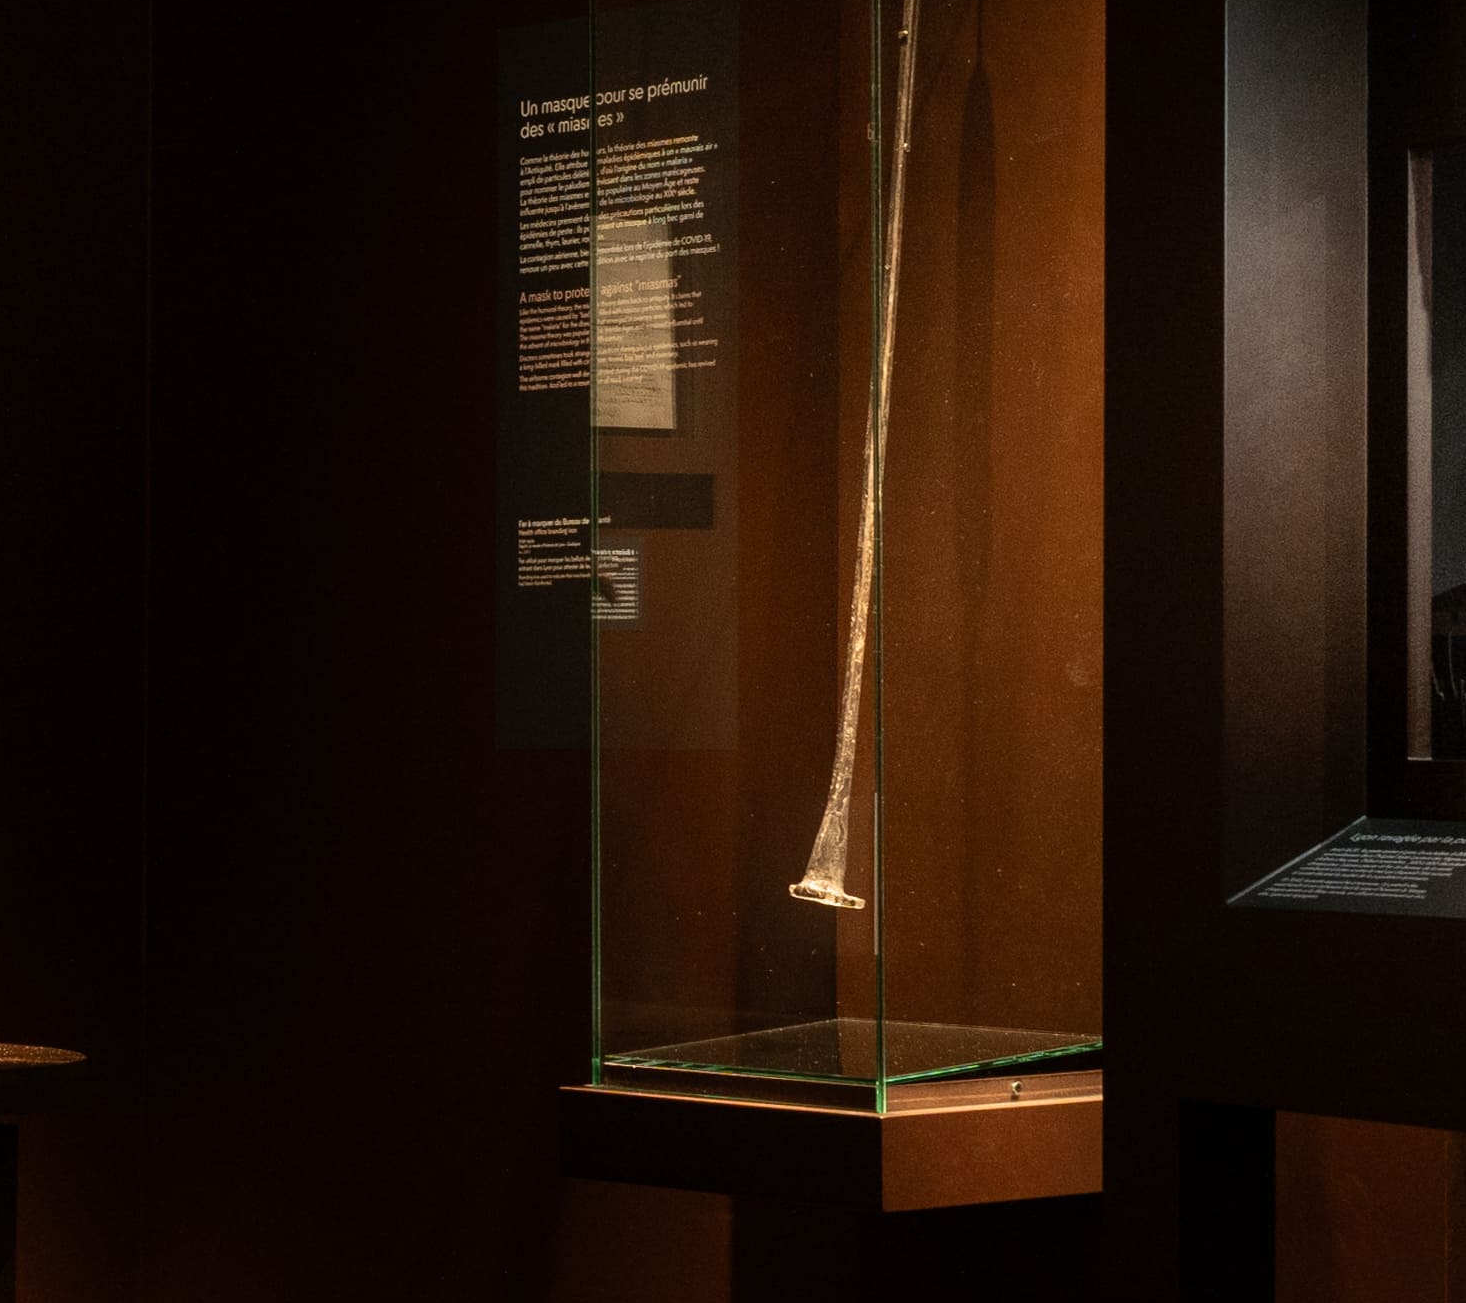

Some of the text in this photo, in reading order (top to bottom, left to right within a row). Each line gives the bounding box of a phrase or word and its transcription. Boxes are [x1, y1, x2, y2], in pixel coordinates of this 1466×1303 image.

[520, 100, 538, 117] Un
[541, 95, 590, 117] masque
[628, 87, 644, 101] se
[647, 74, 709, 103] prémunir
[520, 121, 544, 139] des
[558, 113, 613, 134] miases
[565, 287, 591, 303] prote
